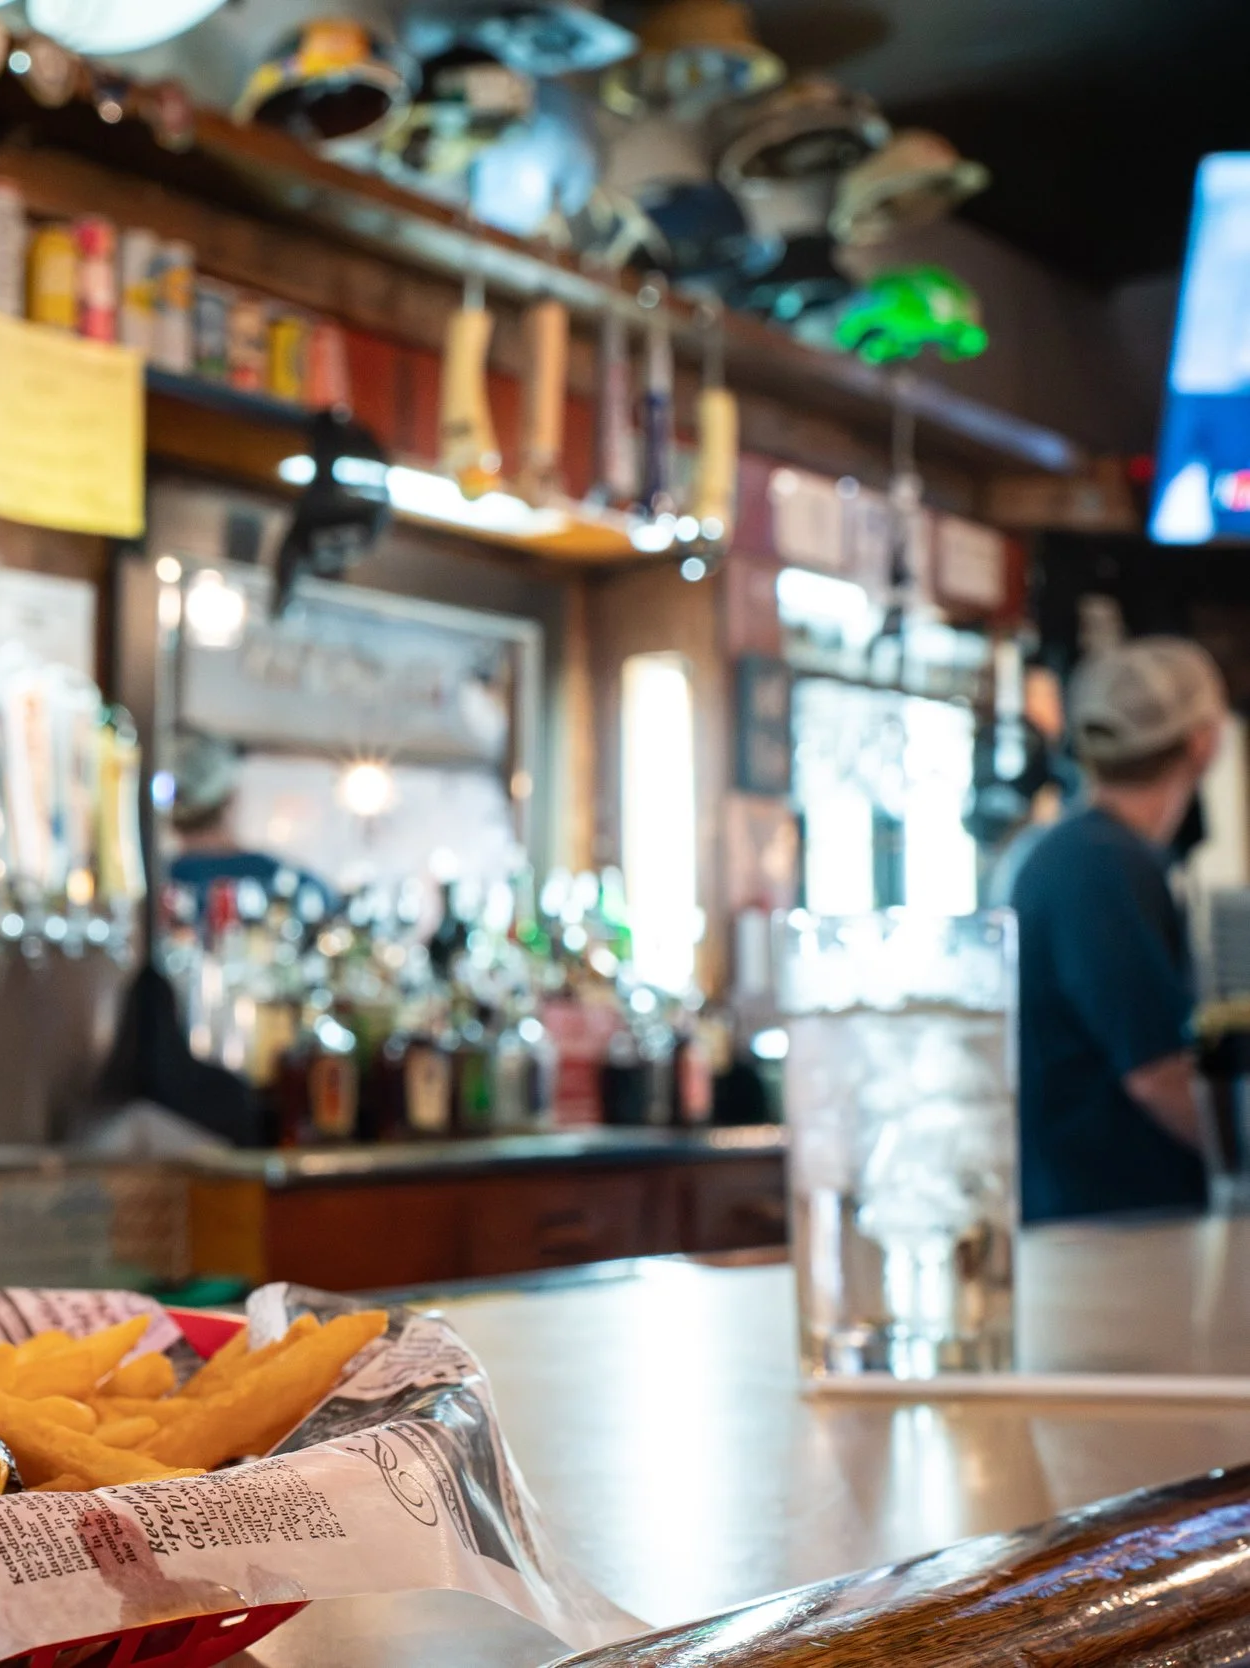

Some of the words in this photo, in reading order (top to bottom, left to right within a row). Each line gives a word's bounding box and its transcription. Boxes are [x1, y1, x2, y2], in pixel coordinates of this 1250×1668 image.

[54, 1497, 70, 1515] the
[79, 1494, 96, 1512] for
[167, 1494, 188, 1513] To
[190, 1484, 219, 1520] largest
[243, 1491, 258, 1516] win
[248, 1481, 264, 1507] only
[264, 1496, 278, 1517] but
[314, 1491, 337, 1519] you!
[177, 1484, 220, 1548] WILLOW,
[231, 1489, 262, 1544] sculptors
[261, 1508, 276, 1533] Not
[281, 1491, 301, 1525] Write
[3, 1505, 31, 1540] years,
[53, 1517, 66, 1530] in
[63, 1516, 80, 1530] of
[110, 1494, 170, 1556] Record
[179, 1518, 206, 1550] Get
[215, 1499, 242, 1545] created
[234, 1508, 253, 1545] town.
[253, 1516, 272, 1544] will
[278, 1504, 303, 1541] potato
[302, 1513, 321, 1539] Post
[315, 1519, 328, 1539] 49,
[333, 1520, 347, 1538] for
[21, 1542, 39, 1557] 25
[26, 1520, 63, 1577] daughter
[36, 1512, 76, 1574] fisherman
[91, 1534, 104, 1549] In
[94, 1514, 126, 1565] evening,
[217, 1526, 233, 1546] the
[64, 1535, 89, 1571] fallen
[77, 1532, 101, 1570] ladies
[122, 1541, 138, 1563] the
[34, 1557, 51, 1579] for
